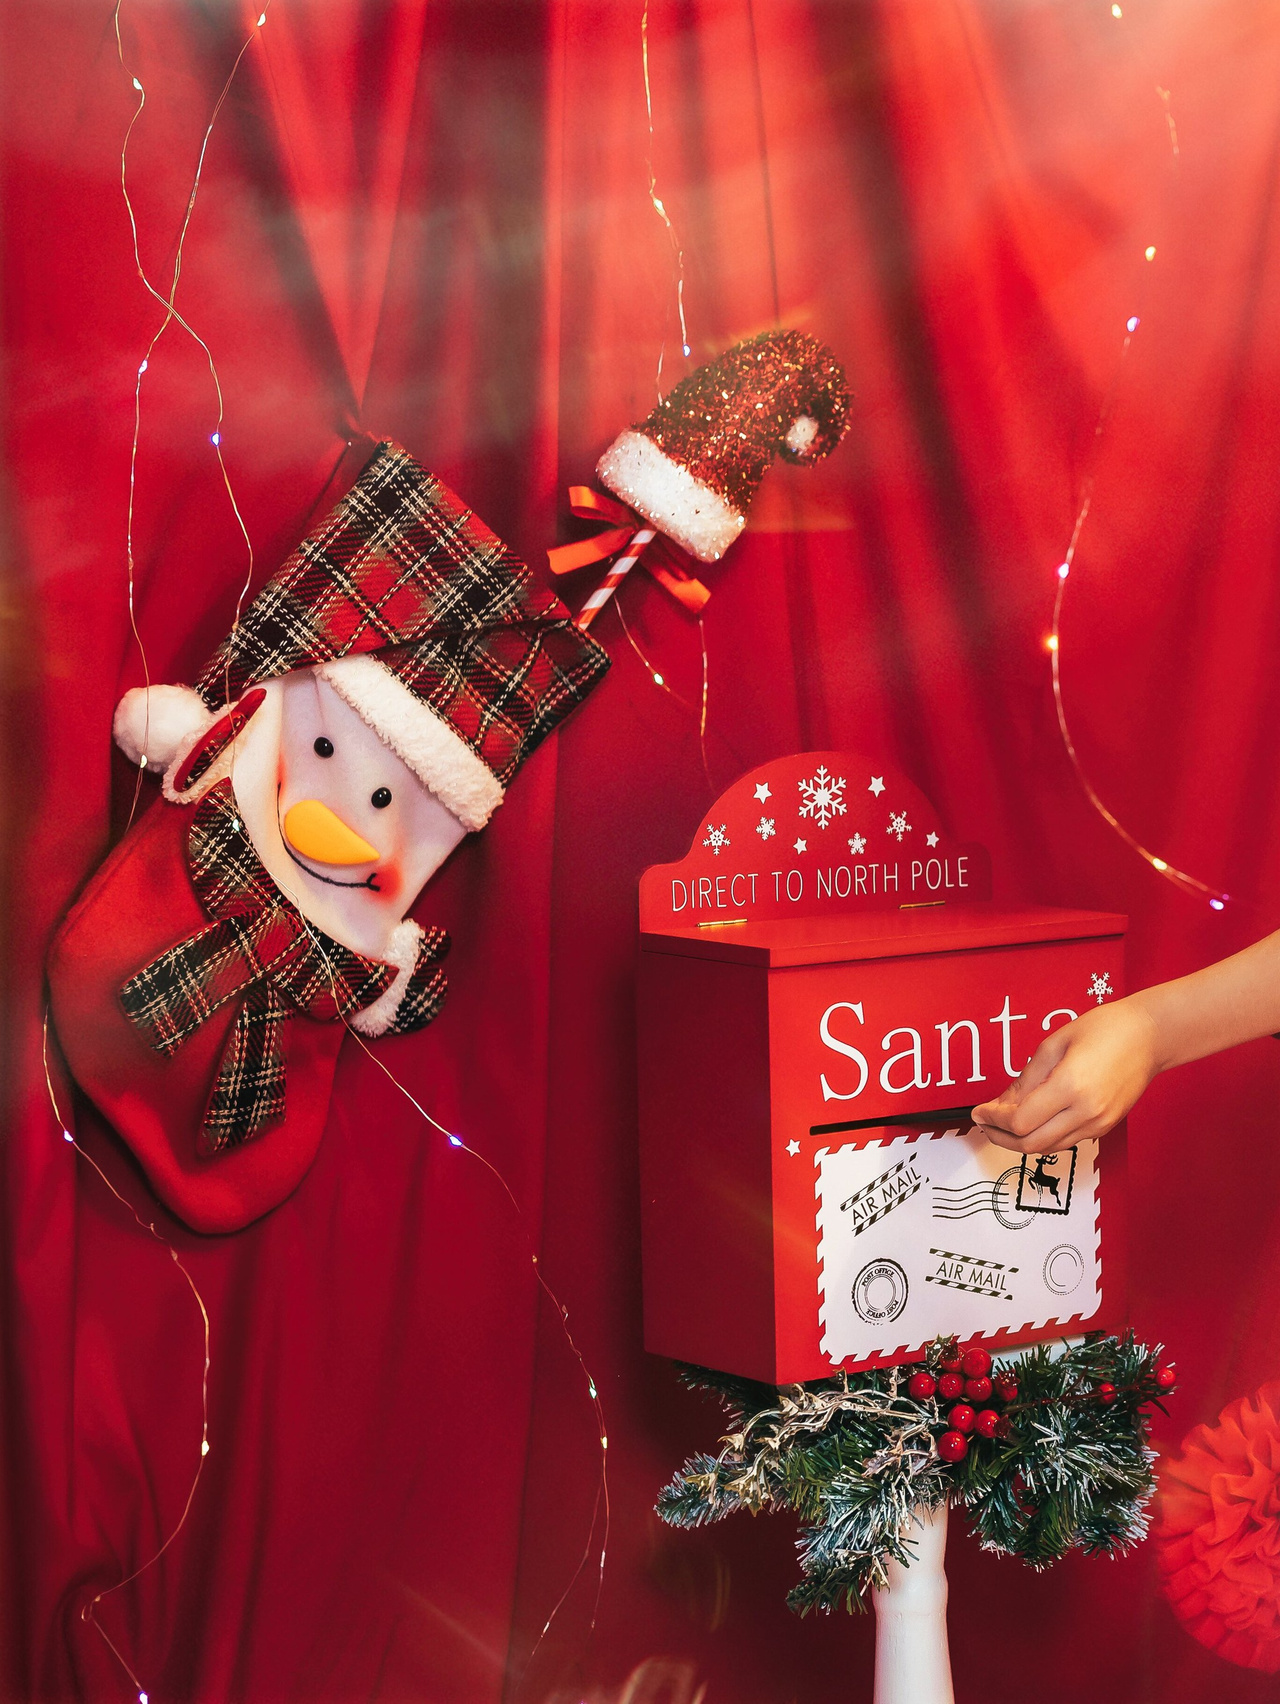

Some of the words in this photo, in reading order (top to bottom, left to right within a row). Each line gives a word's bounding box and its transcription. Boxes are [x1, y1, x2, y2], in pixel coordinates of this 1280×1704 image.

[671, 872, 759, 912] DIRECT
[770, 869, 804, 902] TO
[817, 862, 898, 899] NORTH
[911, 856, 969, 891] POLE
[852, 1196, 879, 1226] AIR
[881, 1166, 922, 1203] MAIL
[861, 1270, 874, 1287] POST
[935, 1260, 964, 1281] AIR
[968, 1267, 1007, 1291] MAIL
